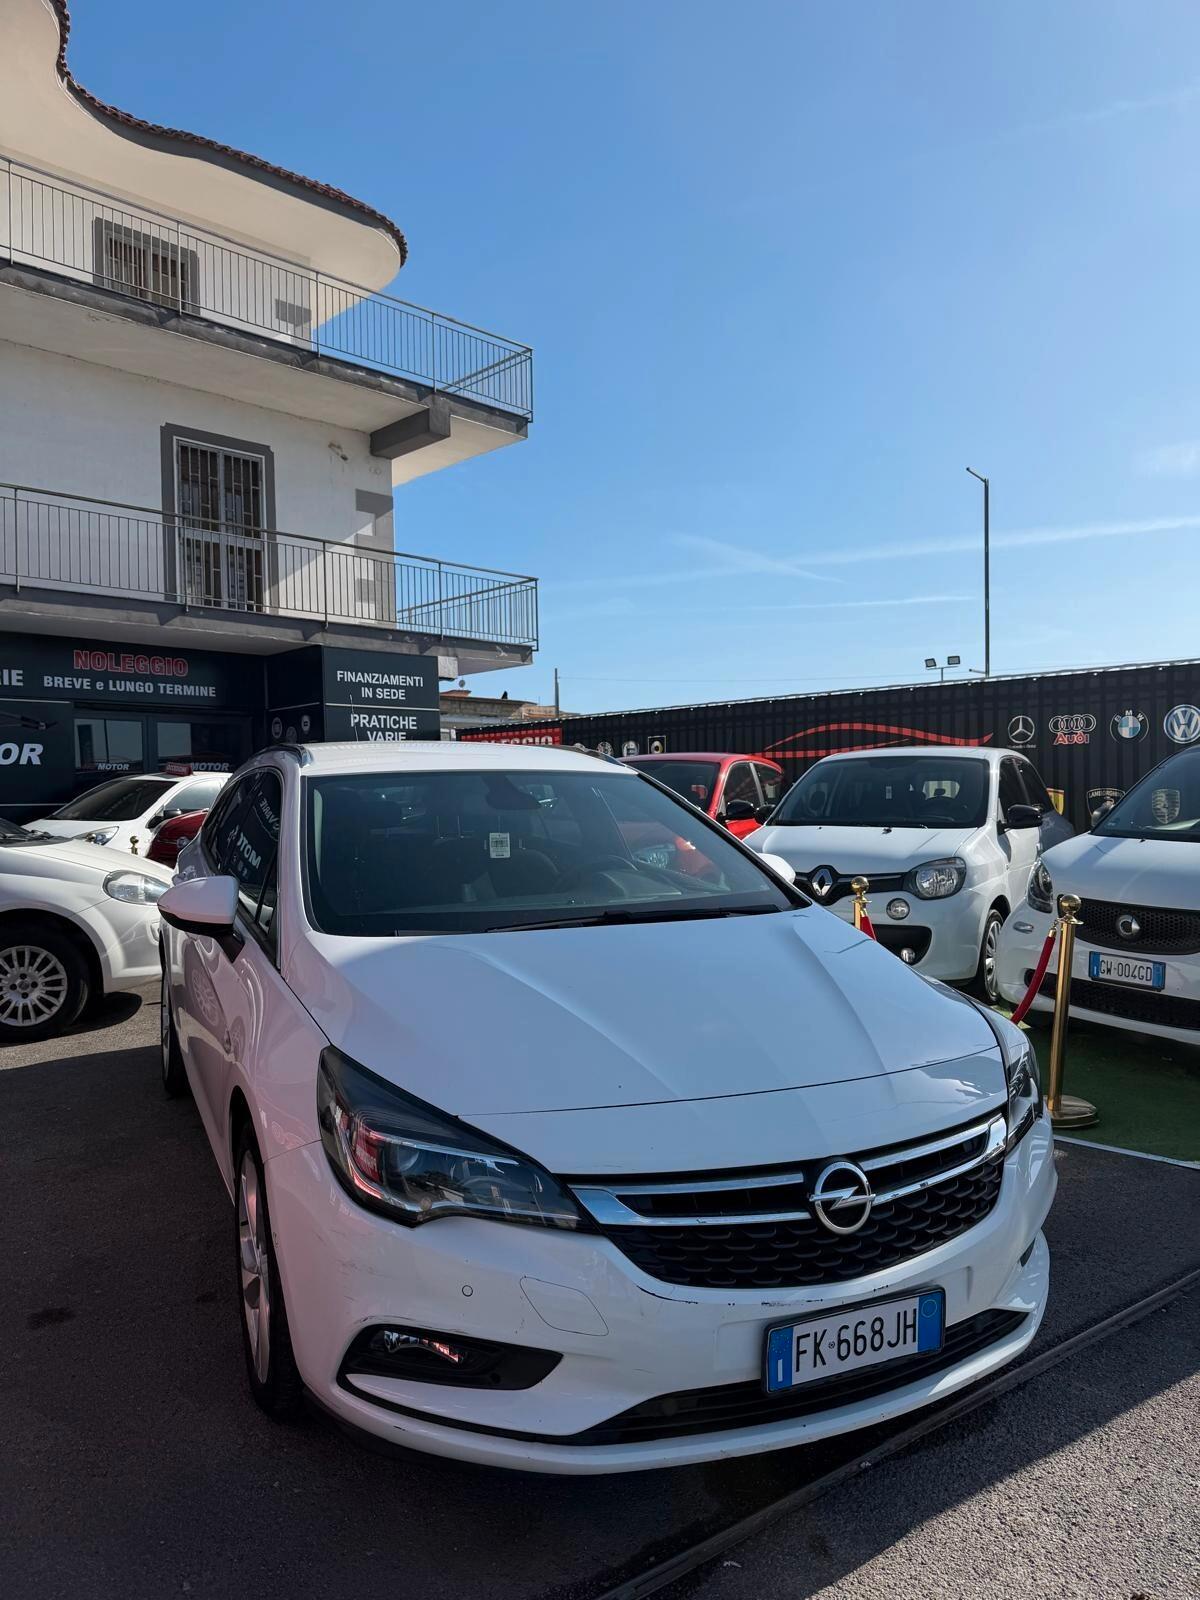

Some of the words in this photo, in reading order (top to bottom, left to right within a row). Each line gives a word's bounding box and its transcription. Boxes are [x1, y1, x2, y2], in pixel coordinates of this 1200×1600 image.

[73, 649, 189, 677] NOLEGGIO
[0, 669, 24, 686] IE
[337, 671, 424, 687] FINANZIAMENTI
[43, 676, 91, 689] BREVE
[96, 681, 104, 690] e
[109, 680, 154, 693] LUNGO
[158, 683, 216, 697] TERMINE
[361, 687, 373, 698] IN
[376, 688, 406, 700] SEDE
[350, 713, 417, 729] PRATICHE
[97, 762, 130, 771] MOTOR
[191, 762, 229, 771] MOTOR
